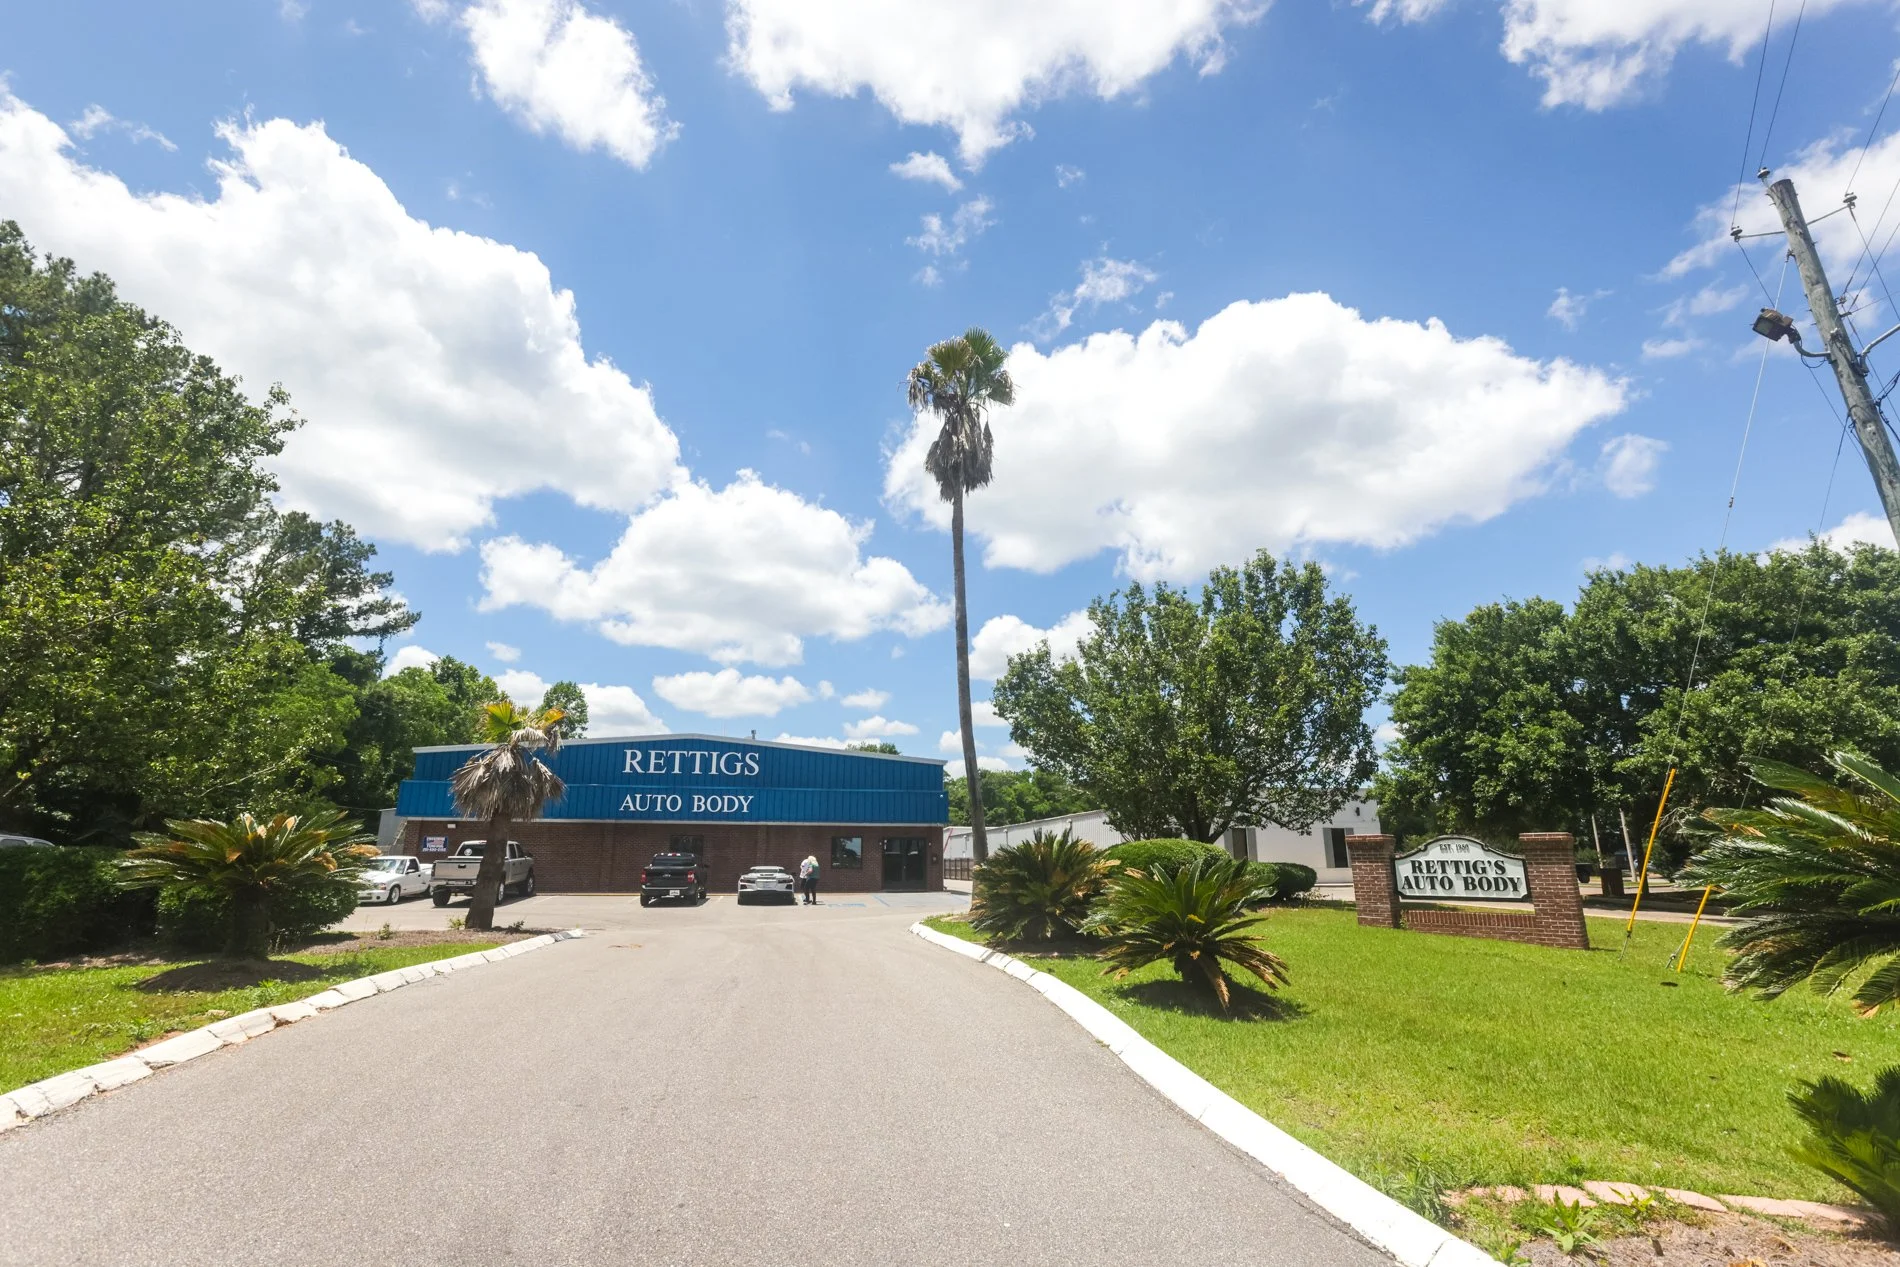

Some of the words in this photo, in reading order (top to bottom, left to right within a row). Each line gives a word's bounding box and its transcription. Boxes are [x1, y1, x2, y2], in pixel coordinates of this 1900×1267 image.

[622, 749, 760, 776] RETTIGS
[619, 794, 682, 812] AUTO
[691, 795, 754, 813] BODY
[1410, 860, 1506, 875] RETTIG'S
[1402, 875, 1454, 890] AUTO
[1462, 876, 1520, 892] BODY
